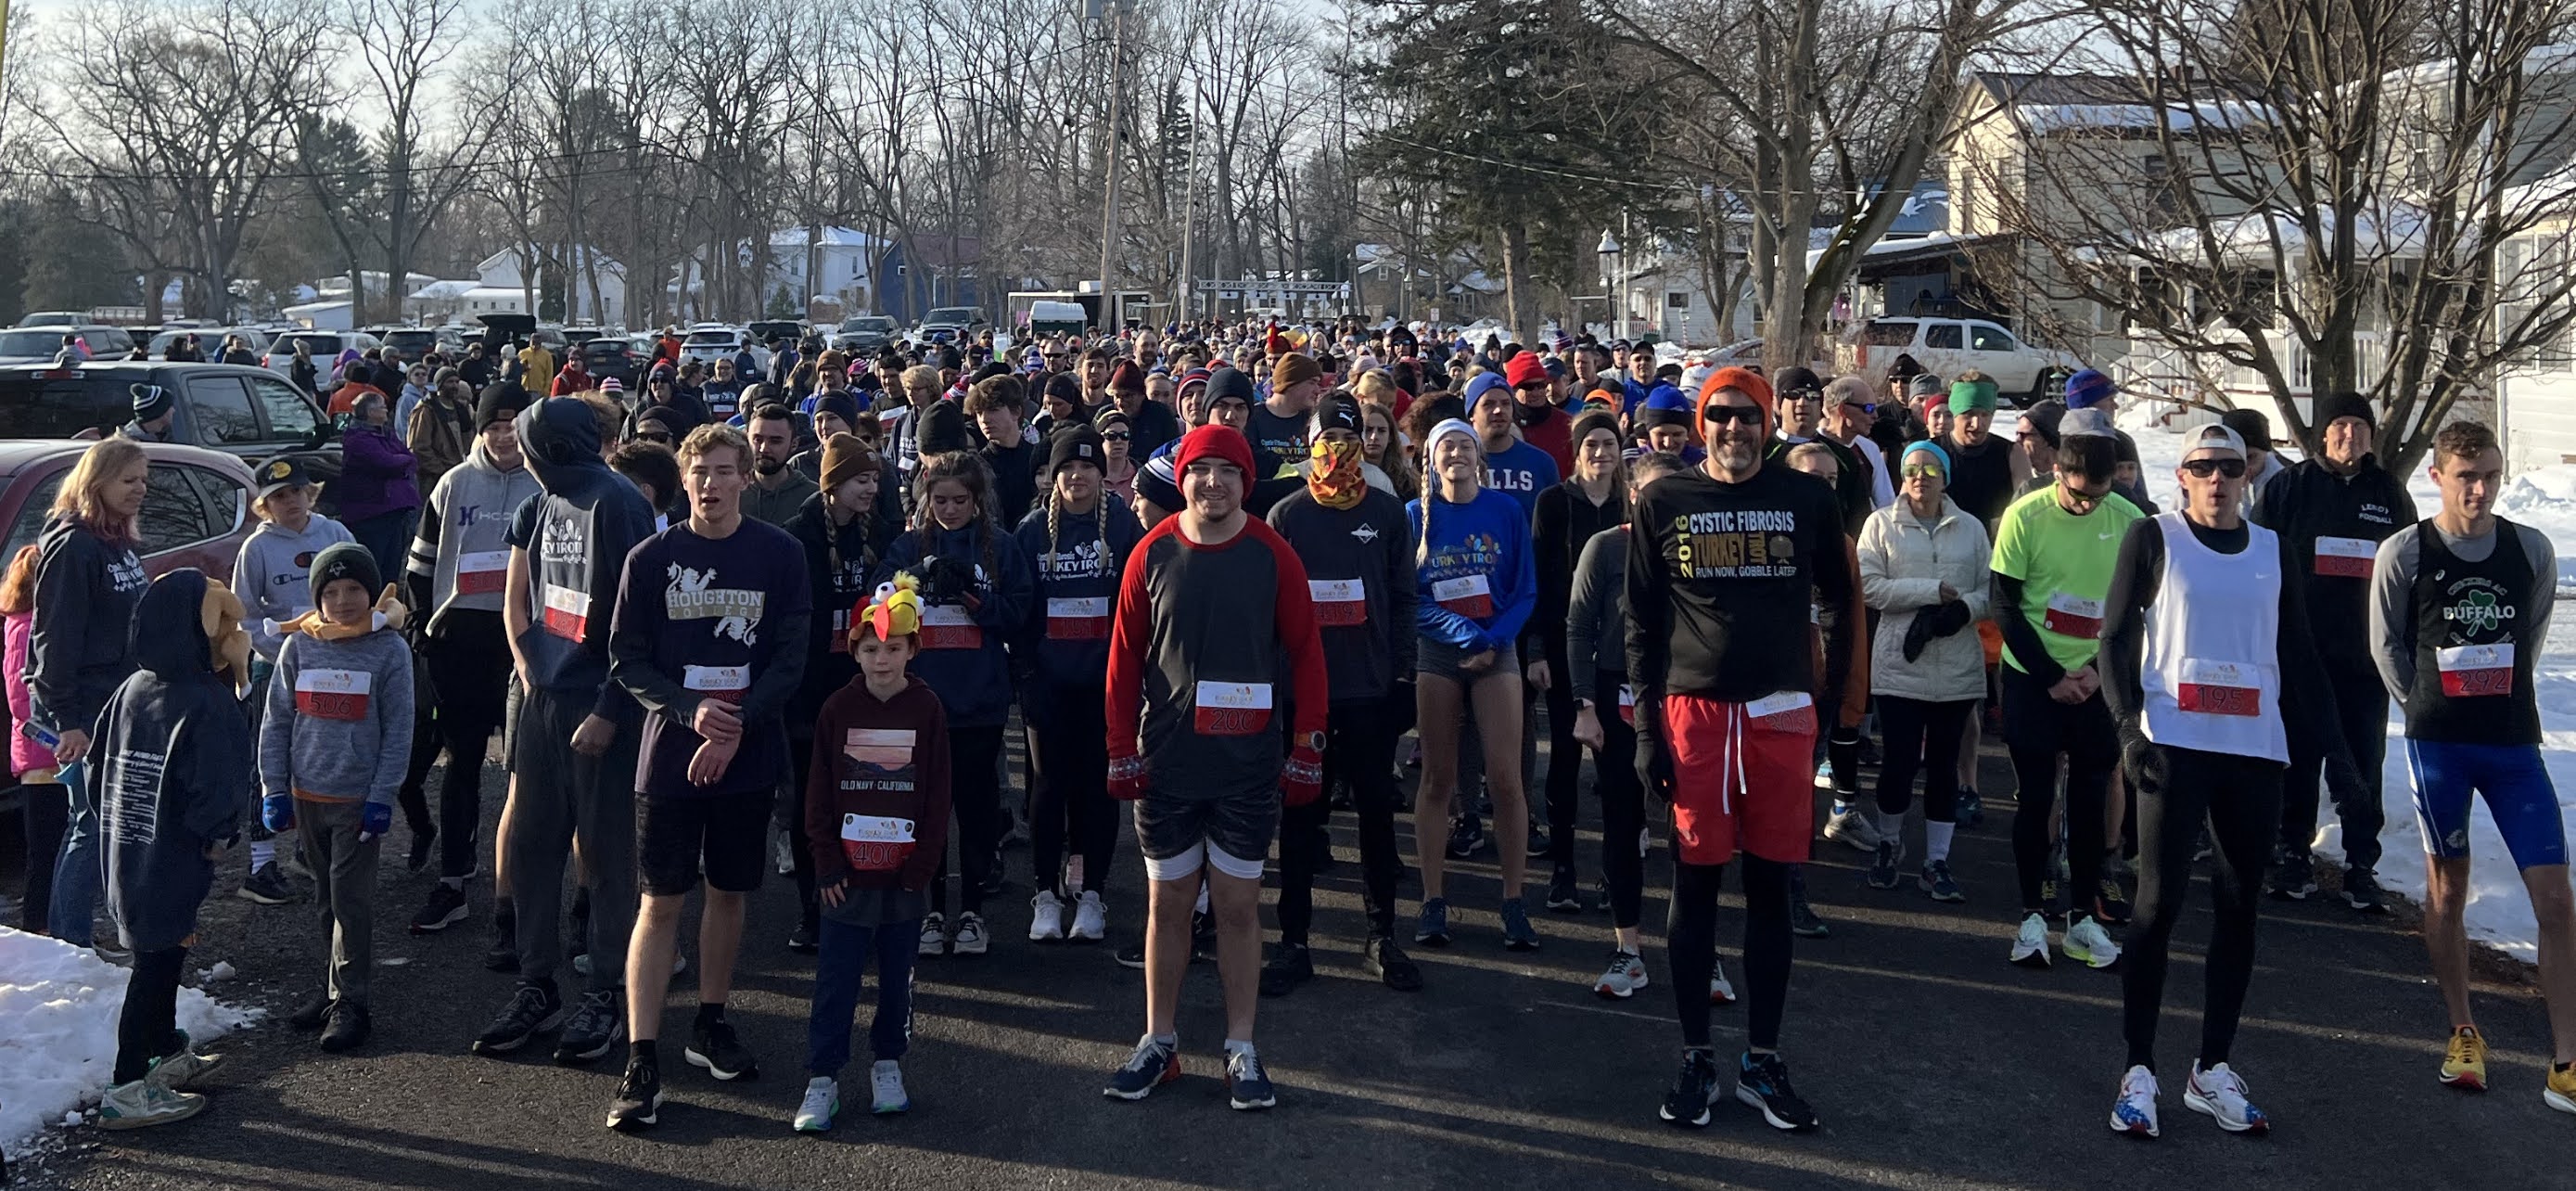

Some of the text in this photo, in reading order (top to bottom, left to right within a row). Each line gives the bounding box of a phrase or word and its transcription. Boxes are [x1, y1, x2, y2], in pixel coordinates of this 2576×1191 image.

[1486, 468, 1533, 492] LLS
[1690, 510, 1795, 534] CYSTIC FIBROSIS
[1675, 515, 1694, 579] 2016
[1691, 532, 1745, 567] TURKEY
[1747, 531, 1767, 565] TROT
[1039, 560, 1079, 572] TUKEY
[1695, 566, 1714, 579] RUN
[1715, 566, 1737, 579] NOW,
[1738, 565, 1772, 578] GOBBLE
[668, 590, 763, 608] HOUGHTON
[668, 606, 762, 619] COLLEGE
[2442, 605, 2517, 621] BUFFALO
[2457, 669, 2509, 693] 292
[310, 692, 352, 715] 506
[2197, 686, 2244, 712] 195
[1209, 709, 1256, 731] 200
[840, 780, 915, 792] OLD NAVY CALIFORNIA
